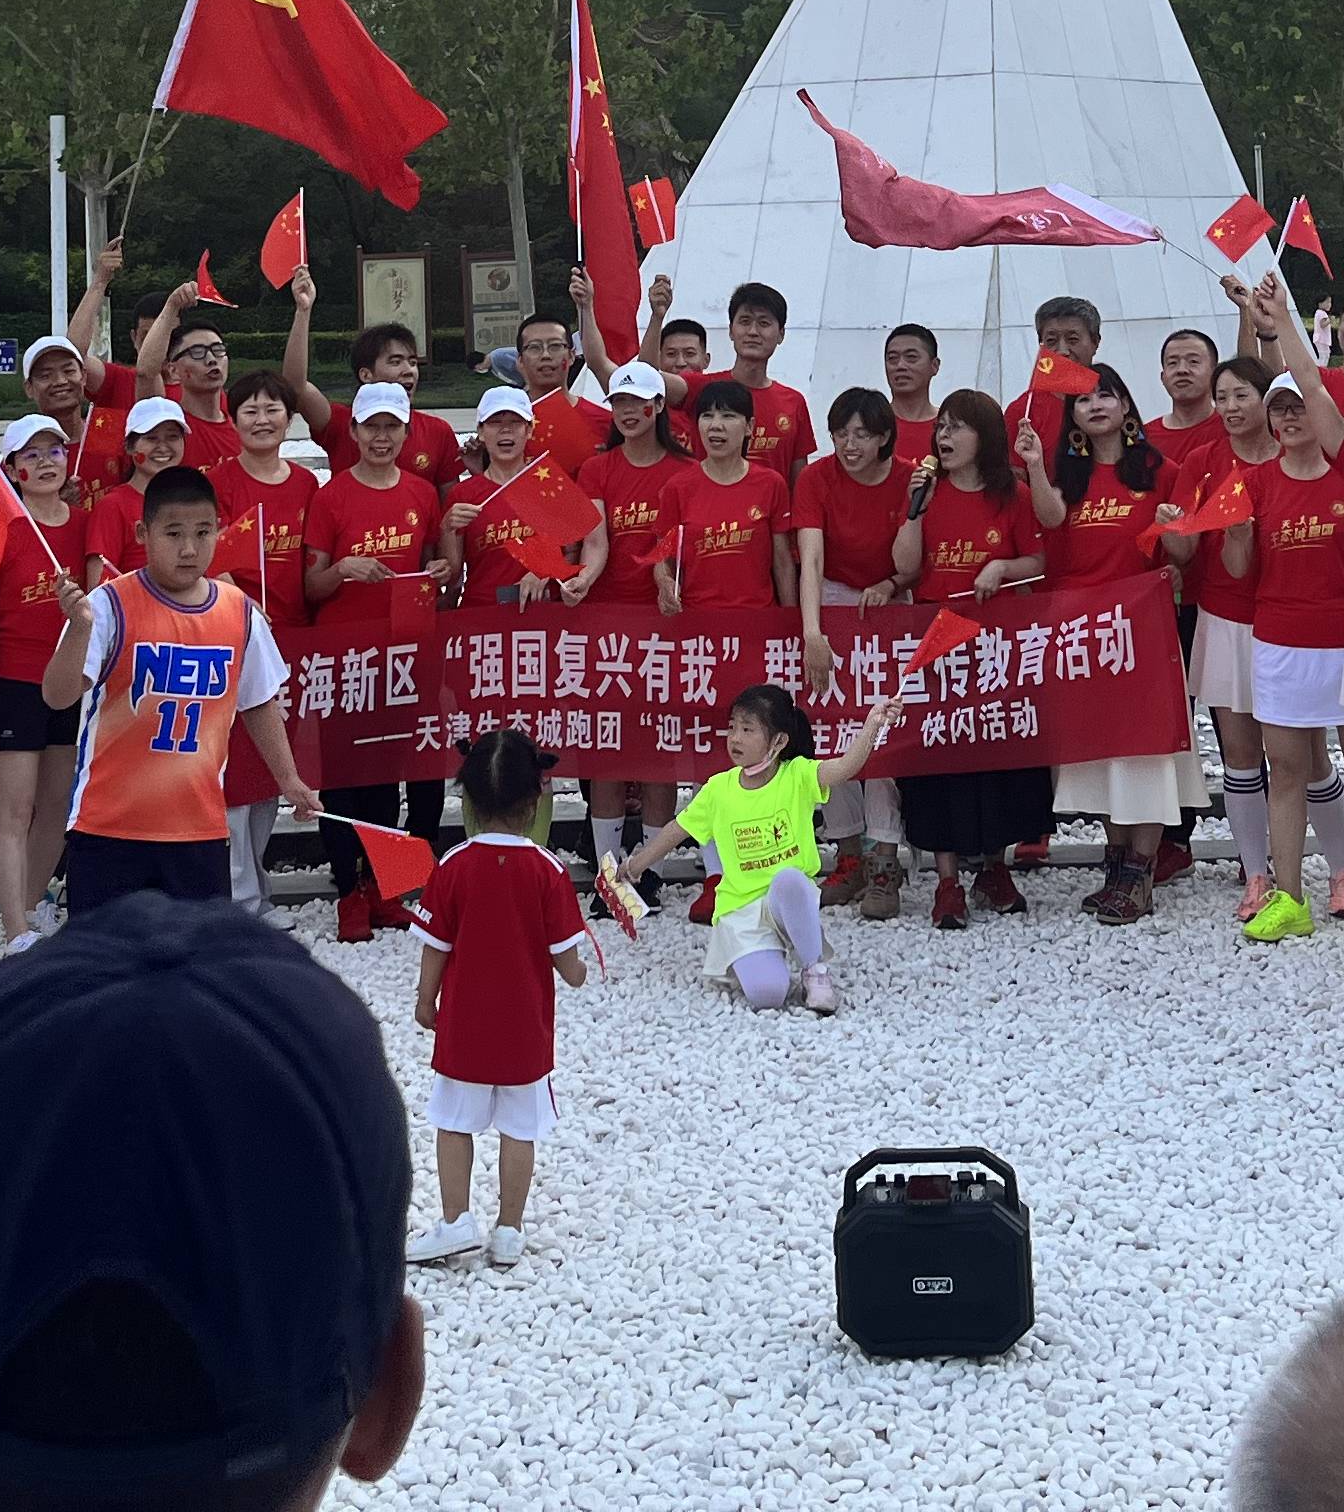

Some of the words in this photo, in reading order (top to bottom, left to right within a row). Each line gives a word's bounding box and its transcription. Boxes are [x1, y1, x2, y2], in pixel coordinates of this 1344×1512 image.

[129, 642, 235, 716] NETS
[150, 700, 203, 754] 11
[735, 825, 761, 837] CHINA
